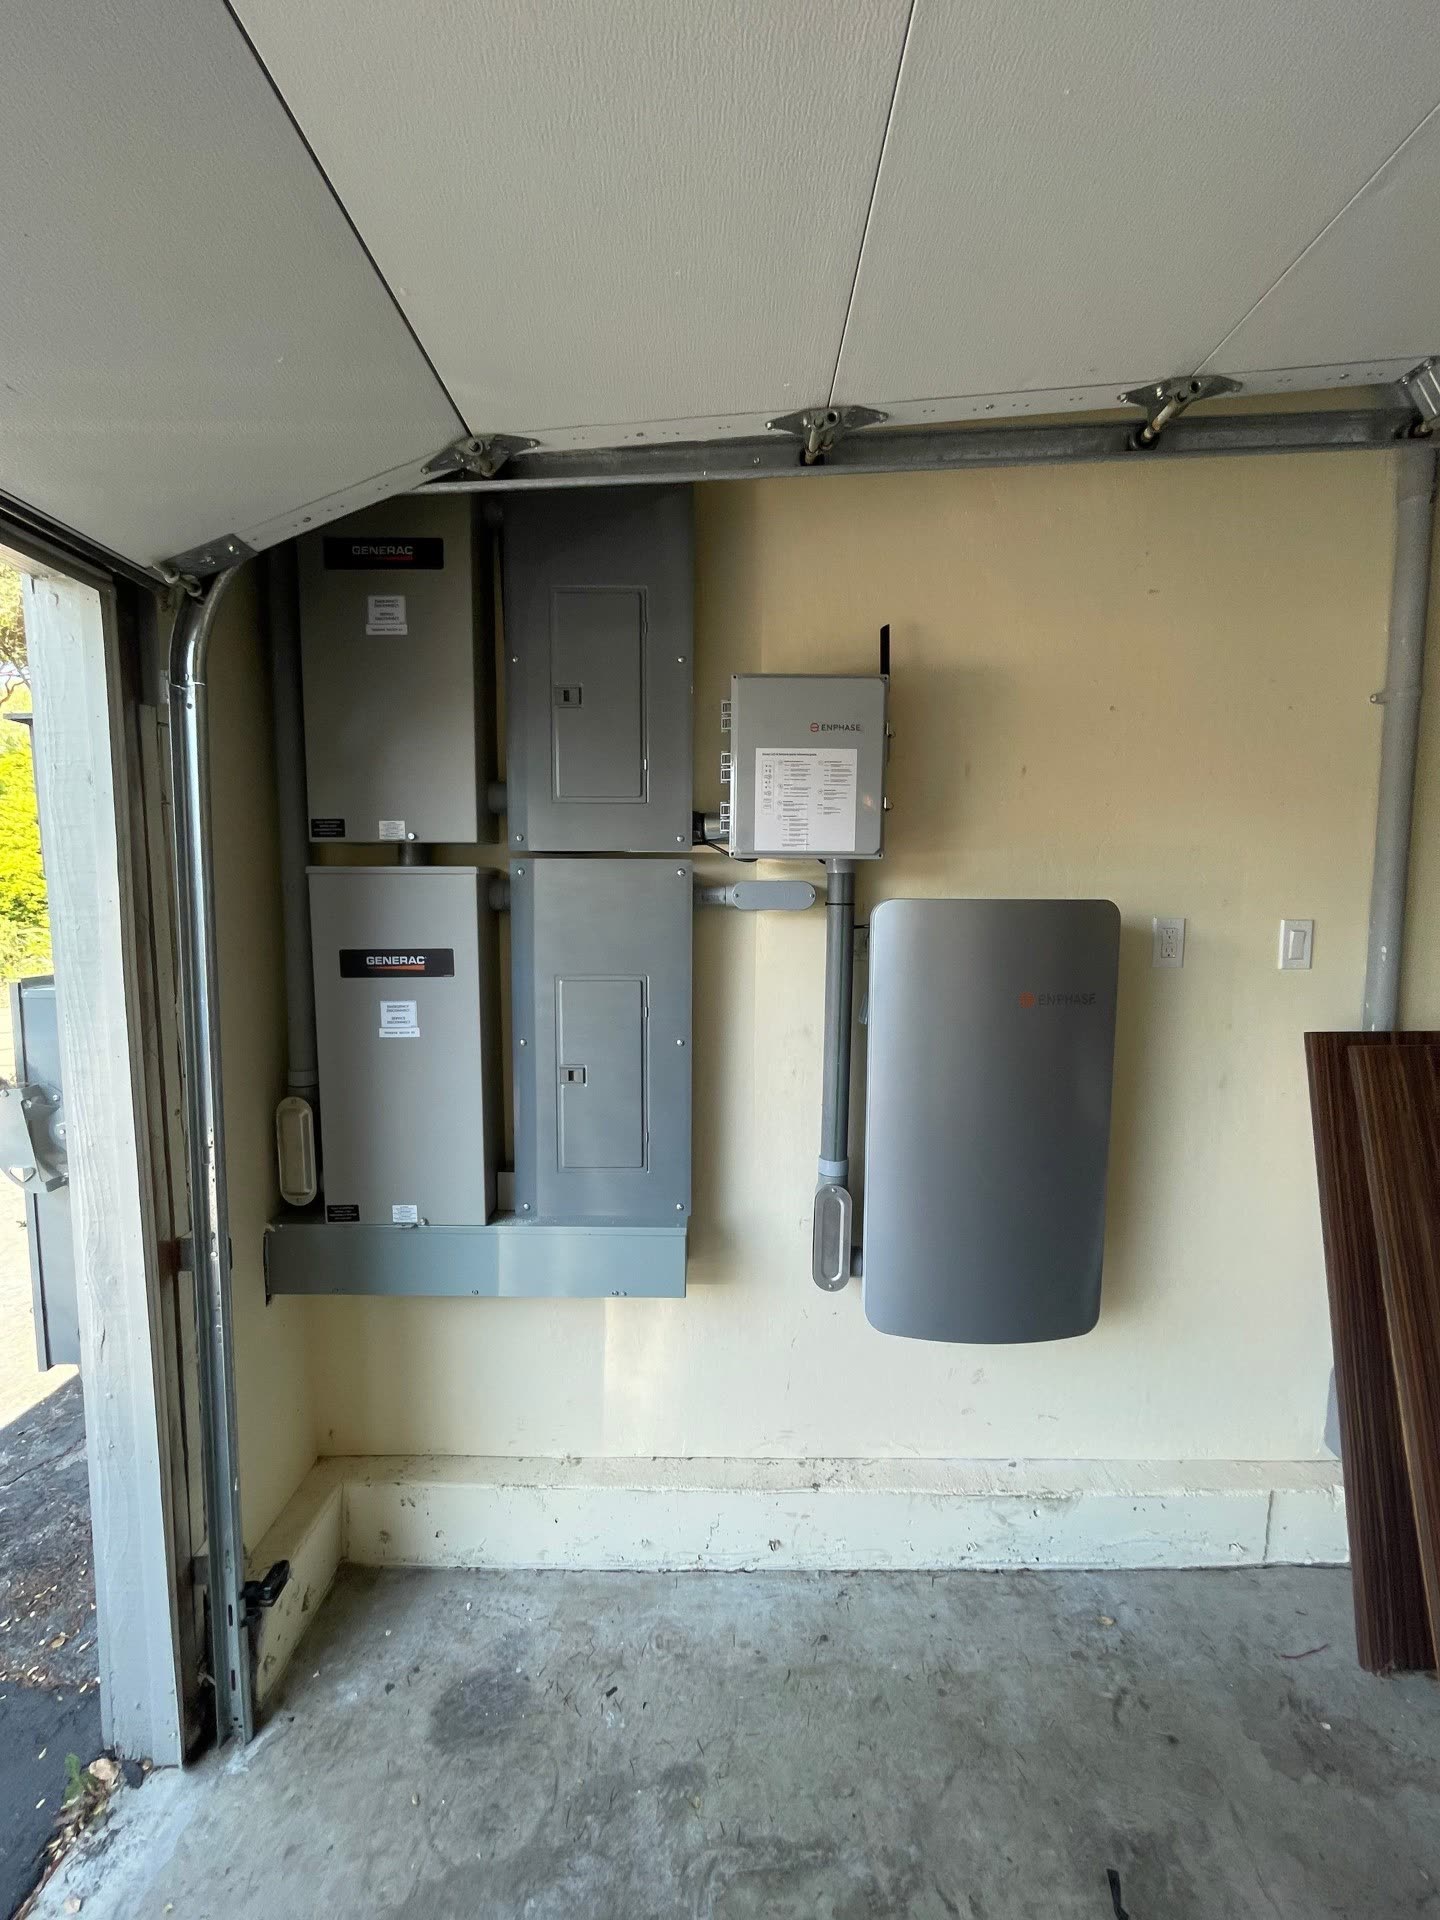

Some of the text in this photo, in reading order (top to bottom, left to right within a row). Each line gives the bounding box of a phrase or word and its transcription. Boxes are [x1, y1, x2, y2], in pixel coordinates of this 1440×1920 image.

[352, 545, 414, 555] GENERAC
[821, 724, 861, 732] ENPHASE
[366, 955, 425, 965] GENERAC
[1038, 992, 1097, 1006] ENPHASE
